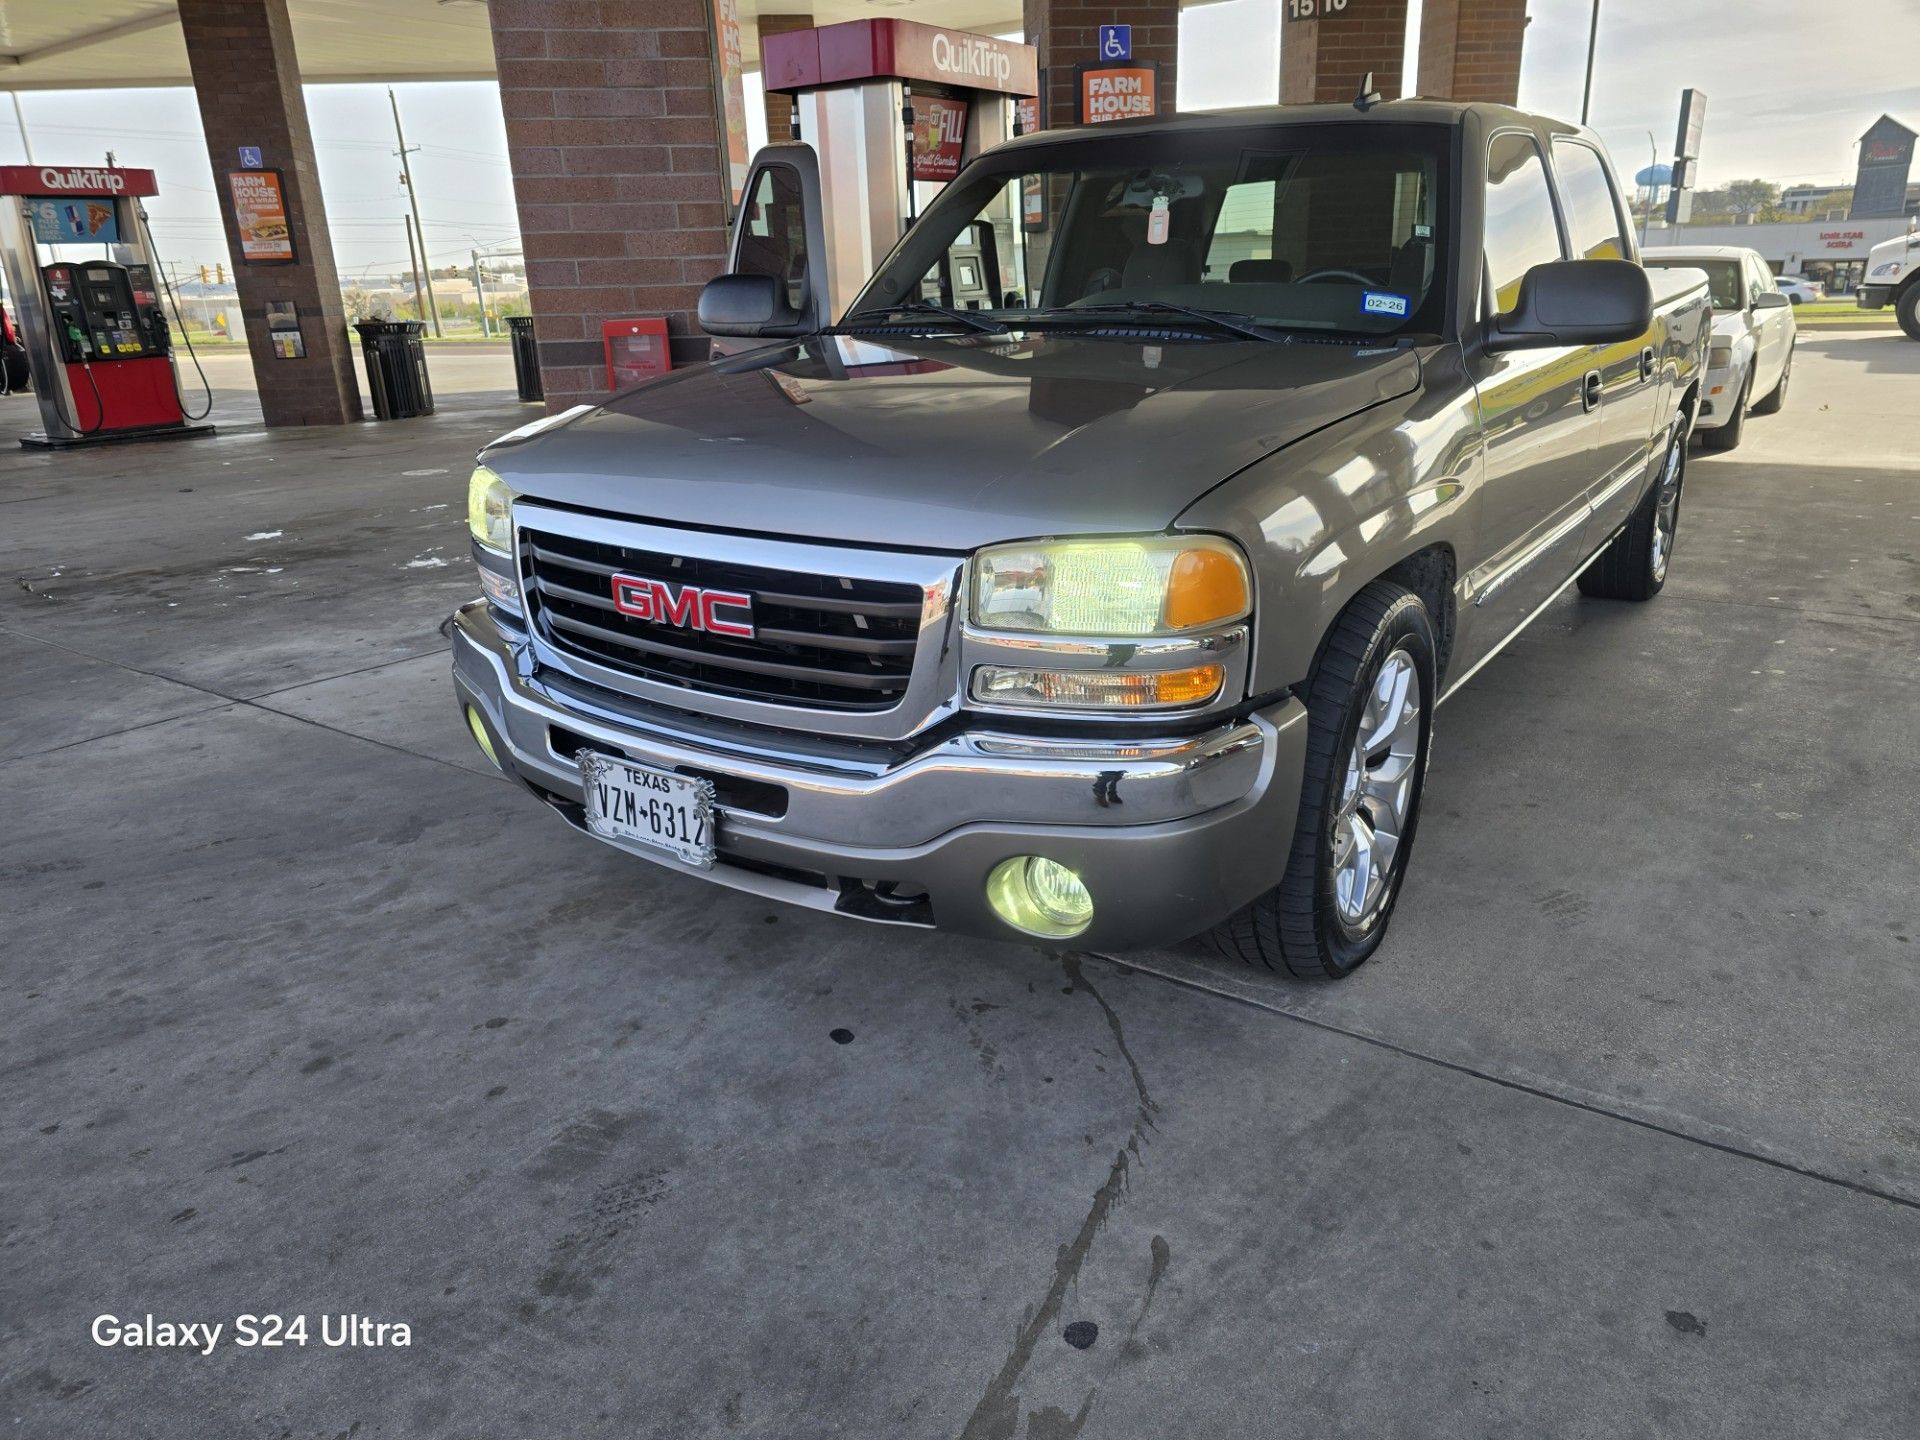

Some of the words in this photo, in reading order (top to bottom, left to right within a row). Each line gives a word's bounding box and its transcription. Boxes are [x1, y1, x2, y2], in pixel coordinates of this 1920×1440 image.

[932, 33, 1010, 88] QuikTrip
[1089, 76, 1142, 95] FARM
[1090, 95, 1151, 114] HOUSE
[938, 109, 963, 143] FILL
[41, 168, 124, 194] QuikTrip
[231, 176, 266, 187] FARM
[234, 187, 277, 198] HOUSE
[611, 573, 755, 639] GMC
[624, 767, 671, 793] TEXAS
